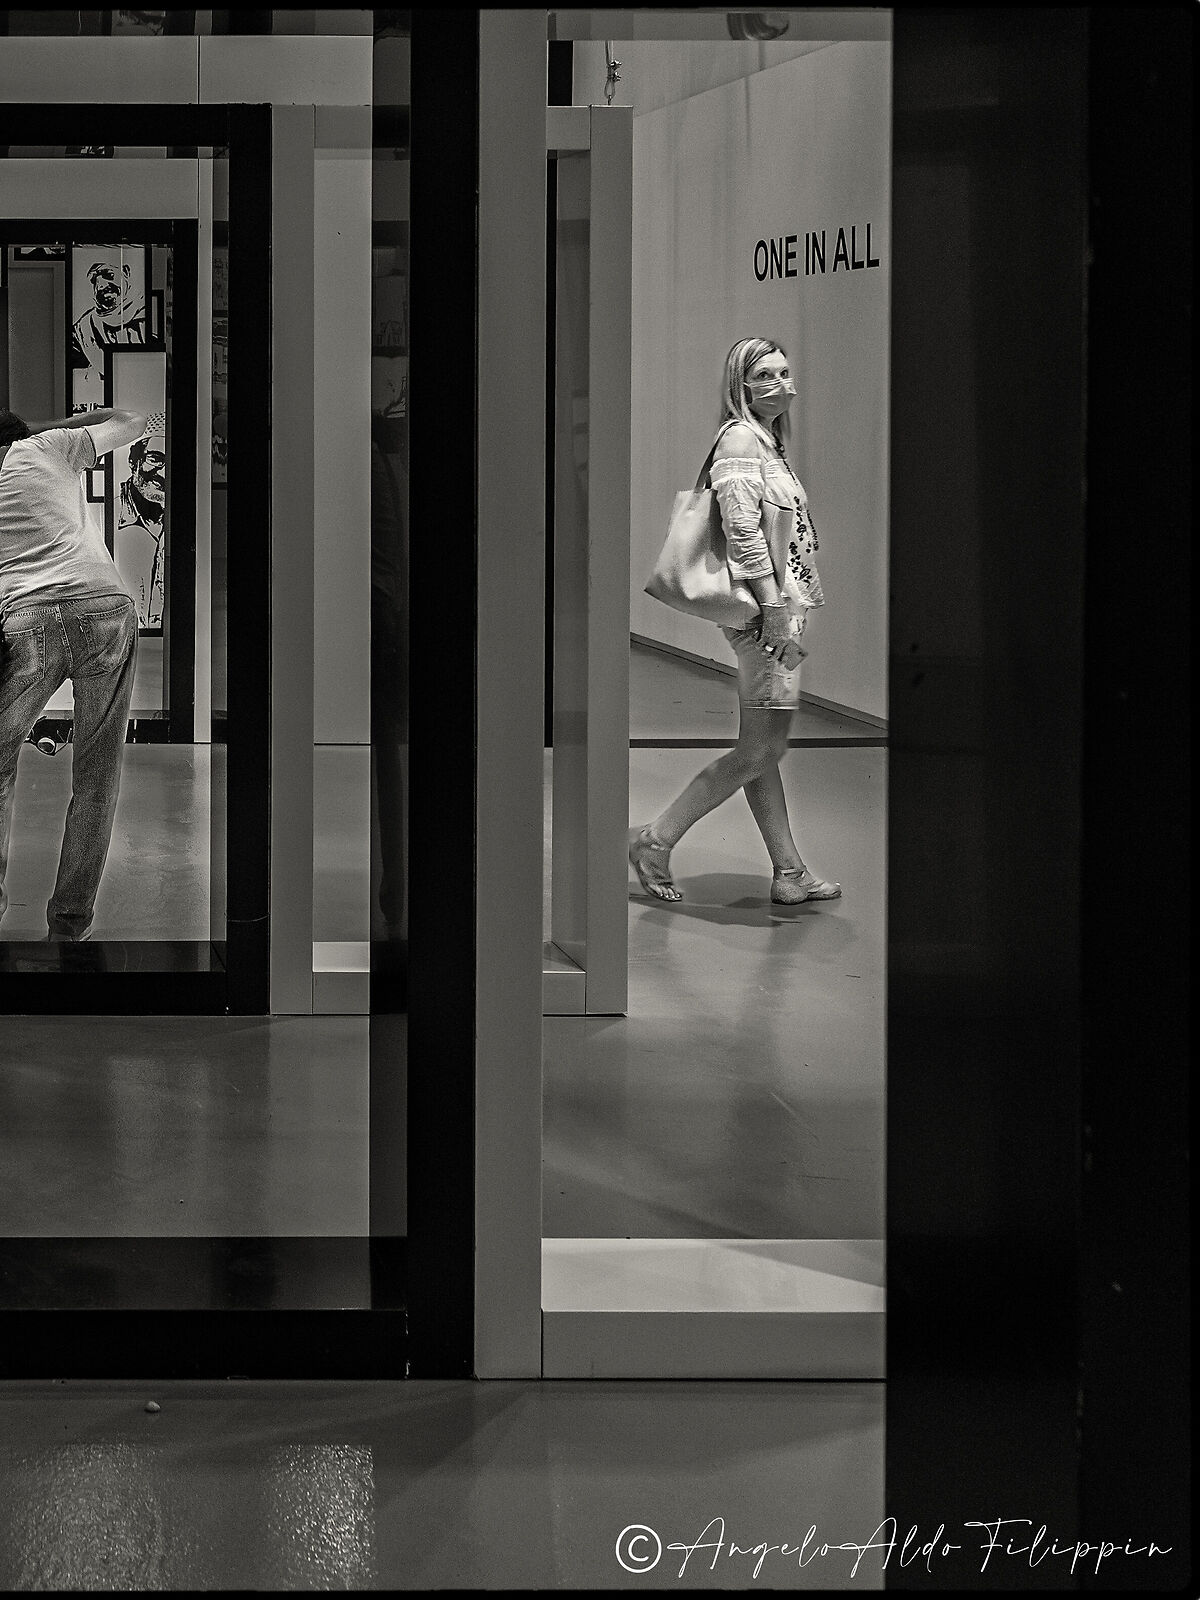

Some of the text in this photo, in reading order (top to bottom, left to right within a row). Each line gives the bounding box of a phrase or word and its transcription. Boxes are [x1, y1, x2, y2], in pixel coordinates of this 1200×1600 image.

[754, 223, 880, 281] ONE IN ALL
